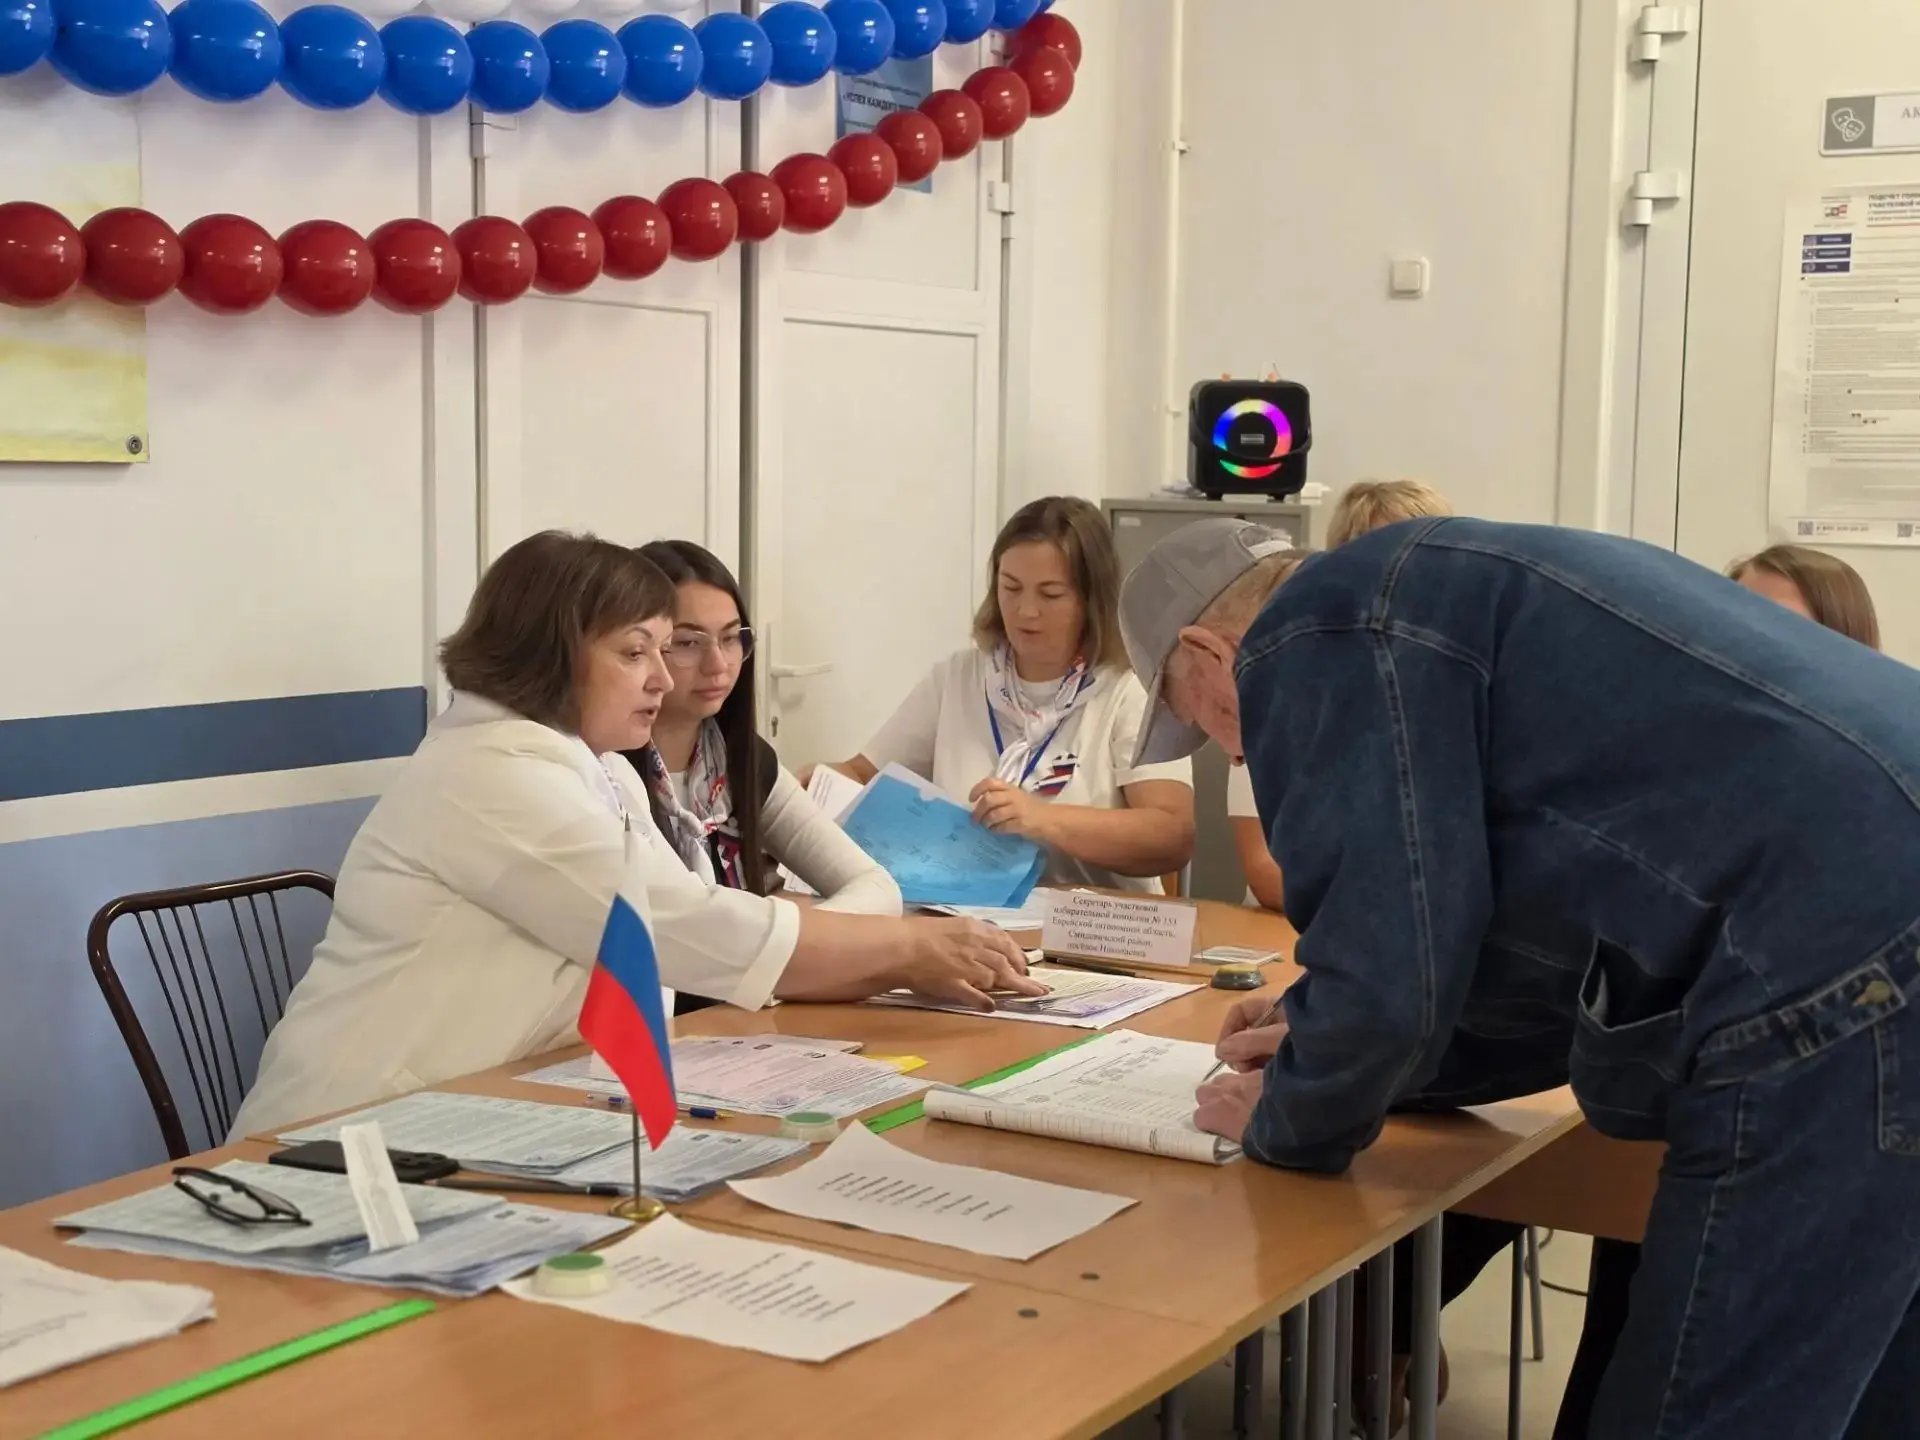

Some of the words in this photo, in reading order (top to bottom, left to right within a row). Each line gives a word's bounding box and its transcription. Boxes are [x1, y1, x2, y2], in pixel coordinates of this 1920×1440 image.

[1072, 896, 1113, 908] Секретарь
[1114, 902, 1159, 912] участковой
[1054, 905, 1111, 919] избирательной
